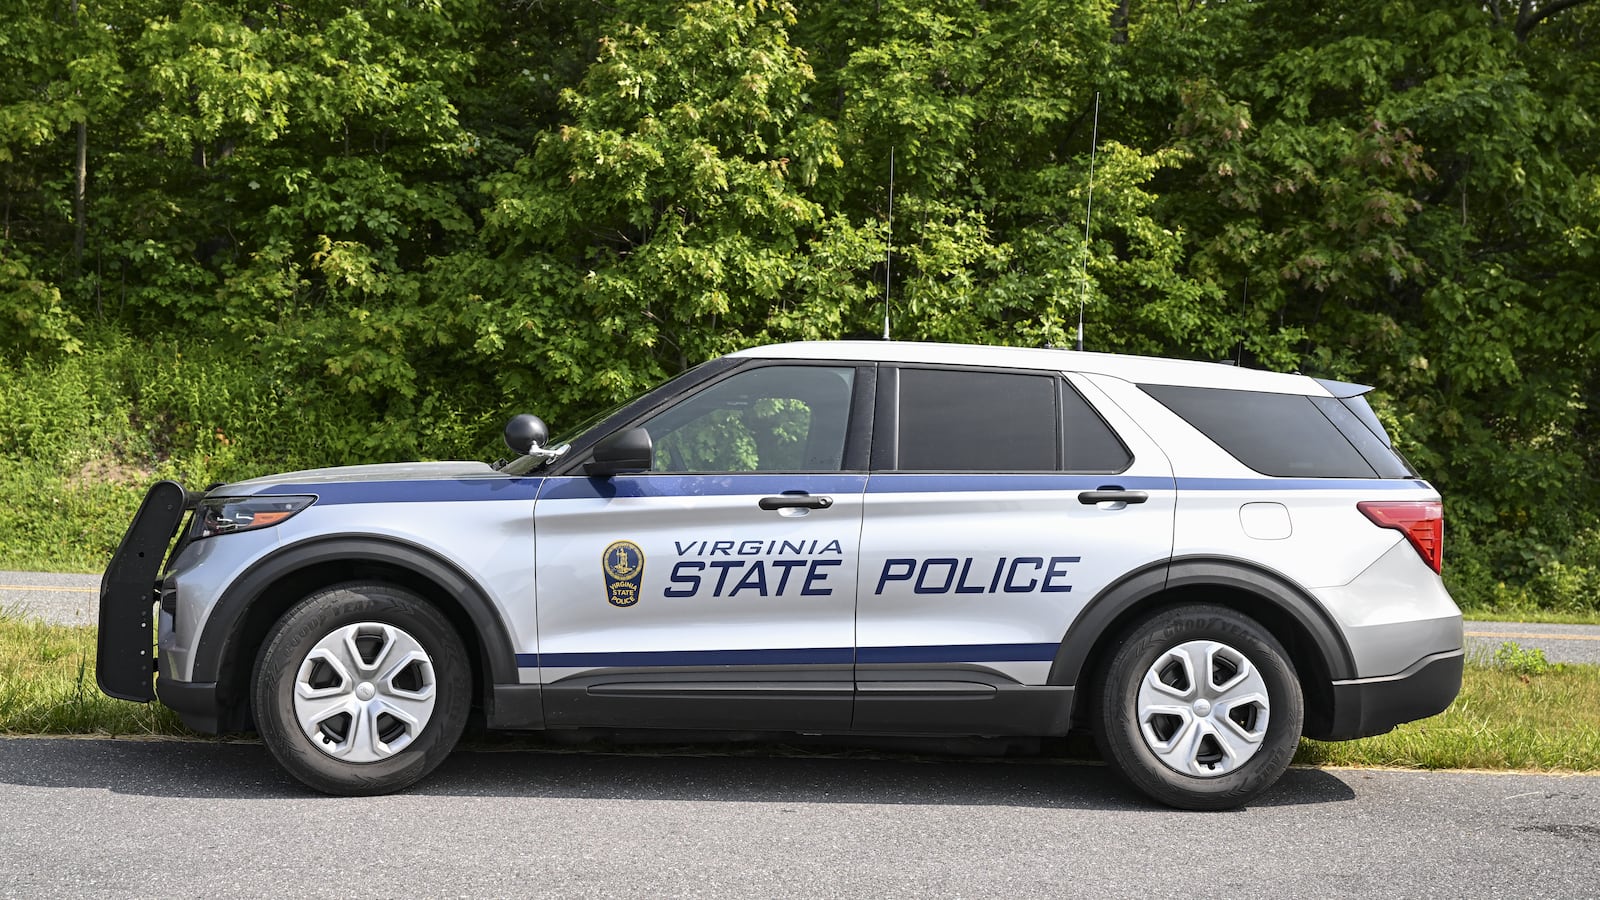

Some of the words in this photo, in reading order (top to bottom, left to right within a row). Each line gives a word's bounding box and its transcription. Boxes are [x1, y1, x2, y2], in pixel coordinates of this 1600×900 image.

[674, 540, 842, 556] VIRGINIA
[663, 559, 843, 597] STATE
[874, 556, 1081, 595] POLICE
[610, 581, 637, 591] VIRGINIA
[611, 596, 635, 604] POLICE
